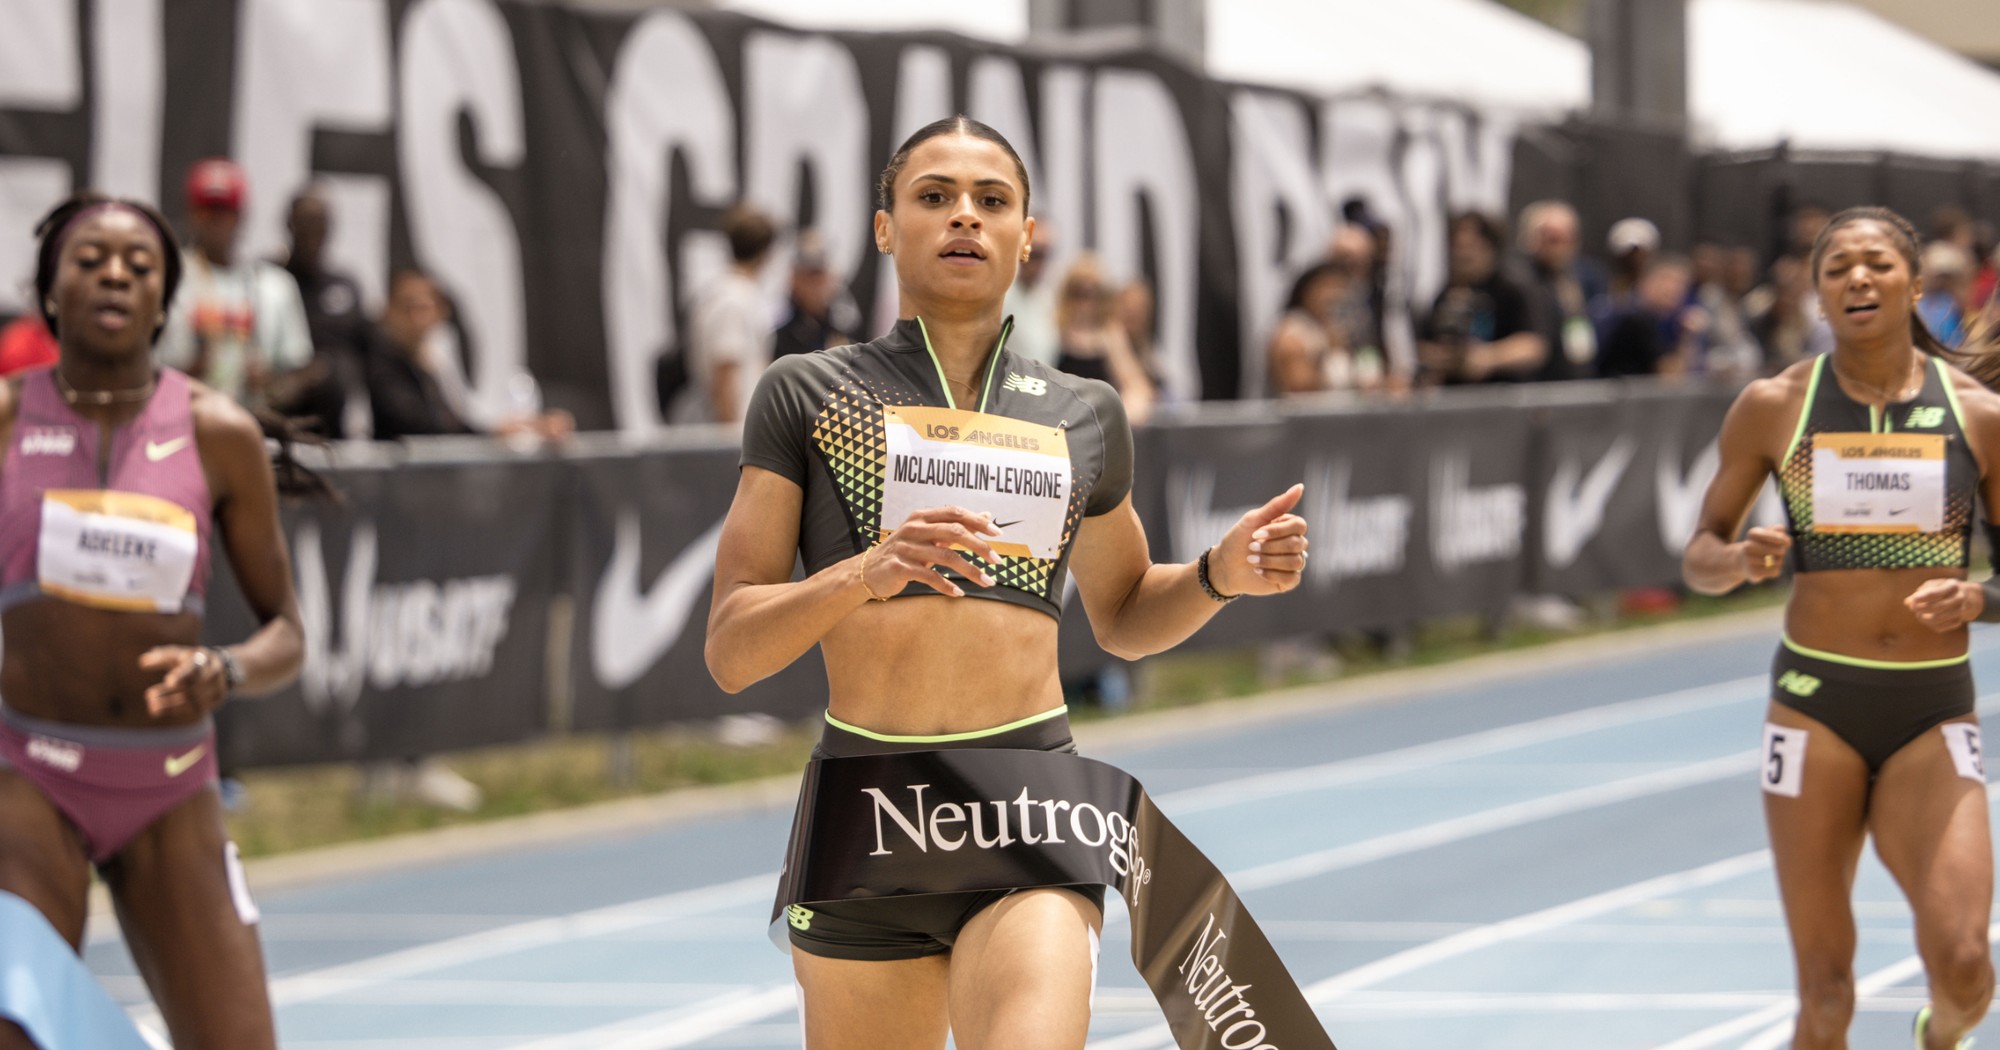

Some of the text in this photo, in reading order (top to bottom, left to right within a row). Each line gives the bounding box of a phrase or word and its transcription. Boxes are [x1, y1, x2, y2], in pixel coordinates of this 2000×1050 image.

[926, 424, 1040, 451] LOS ANGELES
[1841, 446, 1922, 458] LOS ANGELES
[893, 454, 1062, 499] MCLAUGHLIN-LEVRONE
[1845, 472, 1910, 491] THOMAS
[1767, 733, 1786, 785] 5
[1178, 913, 1280, 1050] Neutro
